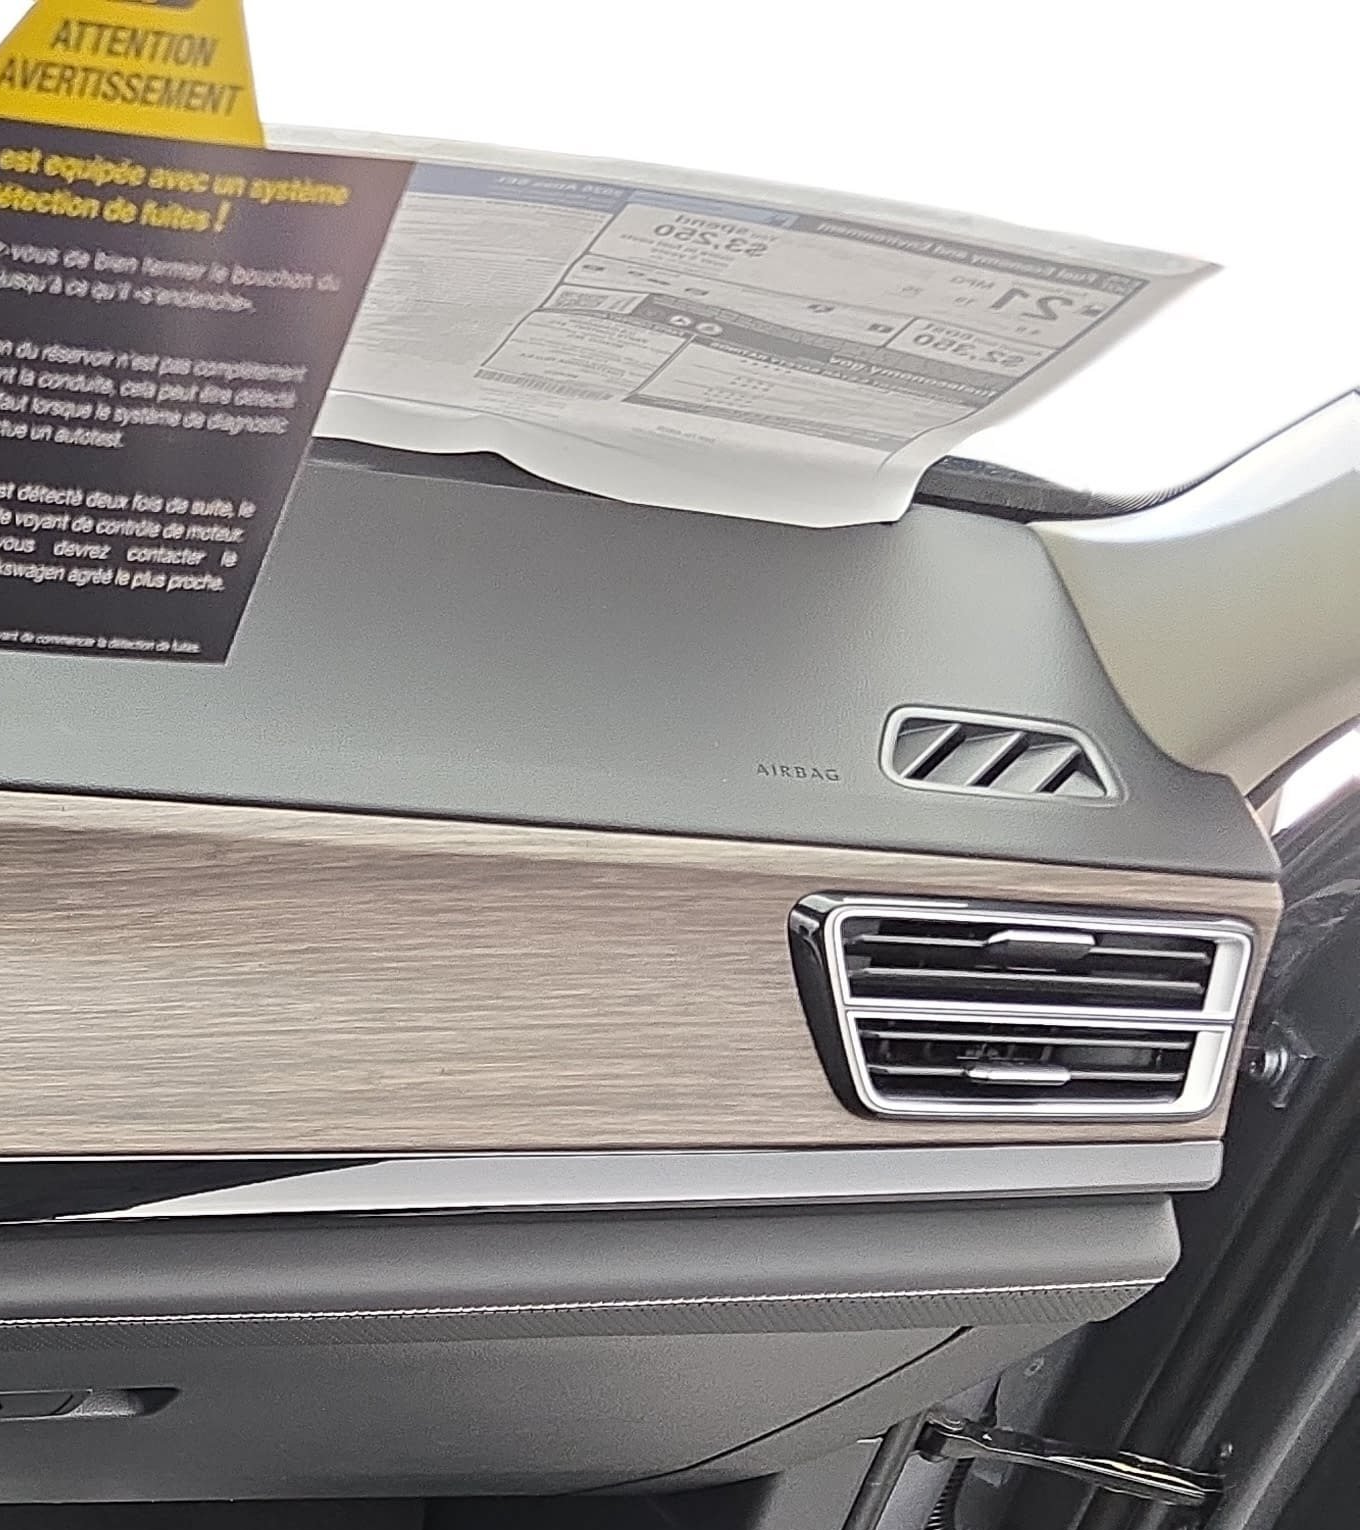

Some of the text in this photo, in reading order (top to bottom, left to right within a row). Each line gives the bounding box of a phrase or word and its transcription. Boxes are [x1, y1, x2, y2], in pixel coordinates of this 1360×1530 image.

[50, 18, 219, 69] ATTENTION
[0, 148, 42, 174] est
[148, 167, 210, 193] avec
[213, 175, 244, 198] un
[248, 176, 349, 206] système
[102, 197, 138, 224] de
[63, 250, 90, 269] de
[95, 249, 138, 274] bien
[141, 257, 207, 280] fermer
[208, 261, 230, 284] le
[232, 264, 314, 289] bouchon
[316, 274, 341, 292] du
[65, 279, 89, 297] ce
[15, 341, 39, 359] du
[41, 344, 115, 367] réservoir
[159, 357, 192, 376] pas
[19, 367, 35, 386] la
[120, 380, 157, 398] cela
[157, 383, 199, 403] peut
[32, 397, 93, 420] lorsque
[95, 403, 112, 421] le
[113, 406, 182, 427] système
[182, 411, 206, 429] de
[30, 425, 53, 441] un
[17, 482, 83, 506] détecté
[86, 491, 128, 510] deux
[132, 492, 164, 512] fois
[165, 498, 189, 514] de
[238, 500, 257, 518] le
[15, 512, 70, 532] voyant
[71, 516, 94, 533] de
[96, 519, 161, 538] contrôle
[163, 524, 185, 540] de
[53, 540, 112, 560] devrez
[127, 545, 207, 565] contacter
[221, 550, 238, 568] le
[68, 568, 114, 587] agréé
[115, 568, 130, 586] le
[131, 570, 166, 590] plus
[757, 764, 840, 781] AIRBAG
